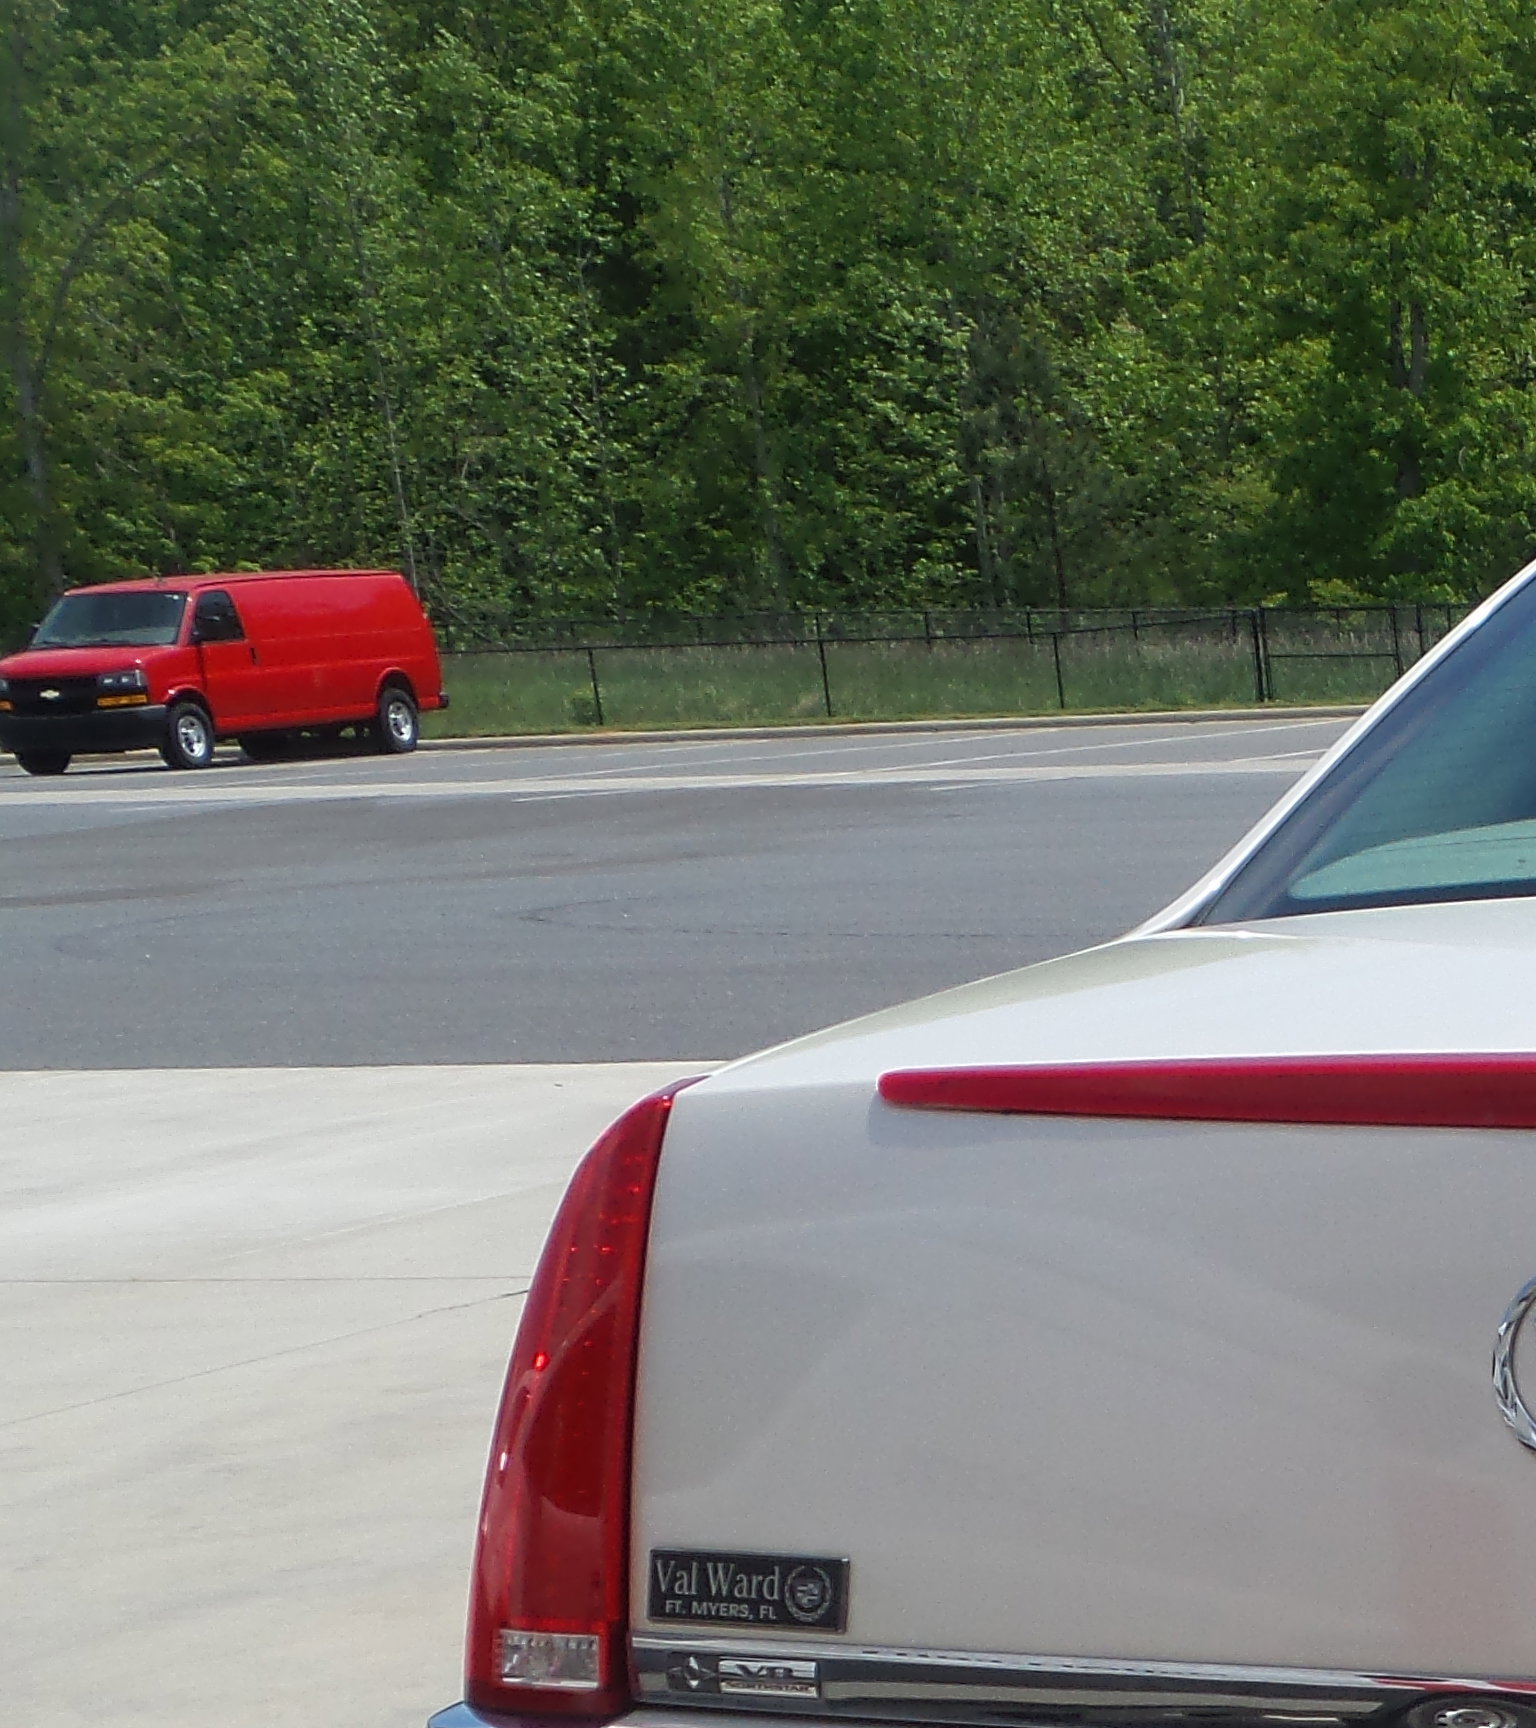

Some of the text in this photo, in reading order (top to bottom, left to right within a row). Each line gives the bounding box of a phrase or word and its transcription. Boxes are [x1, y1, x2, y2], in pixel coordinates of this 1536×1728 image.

[655, 1559, 780, 1601] Val Ward
[665, 1600, 778, 1620] FT. MYERS, FL
[736, 1663, 793, 1681] V8
